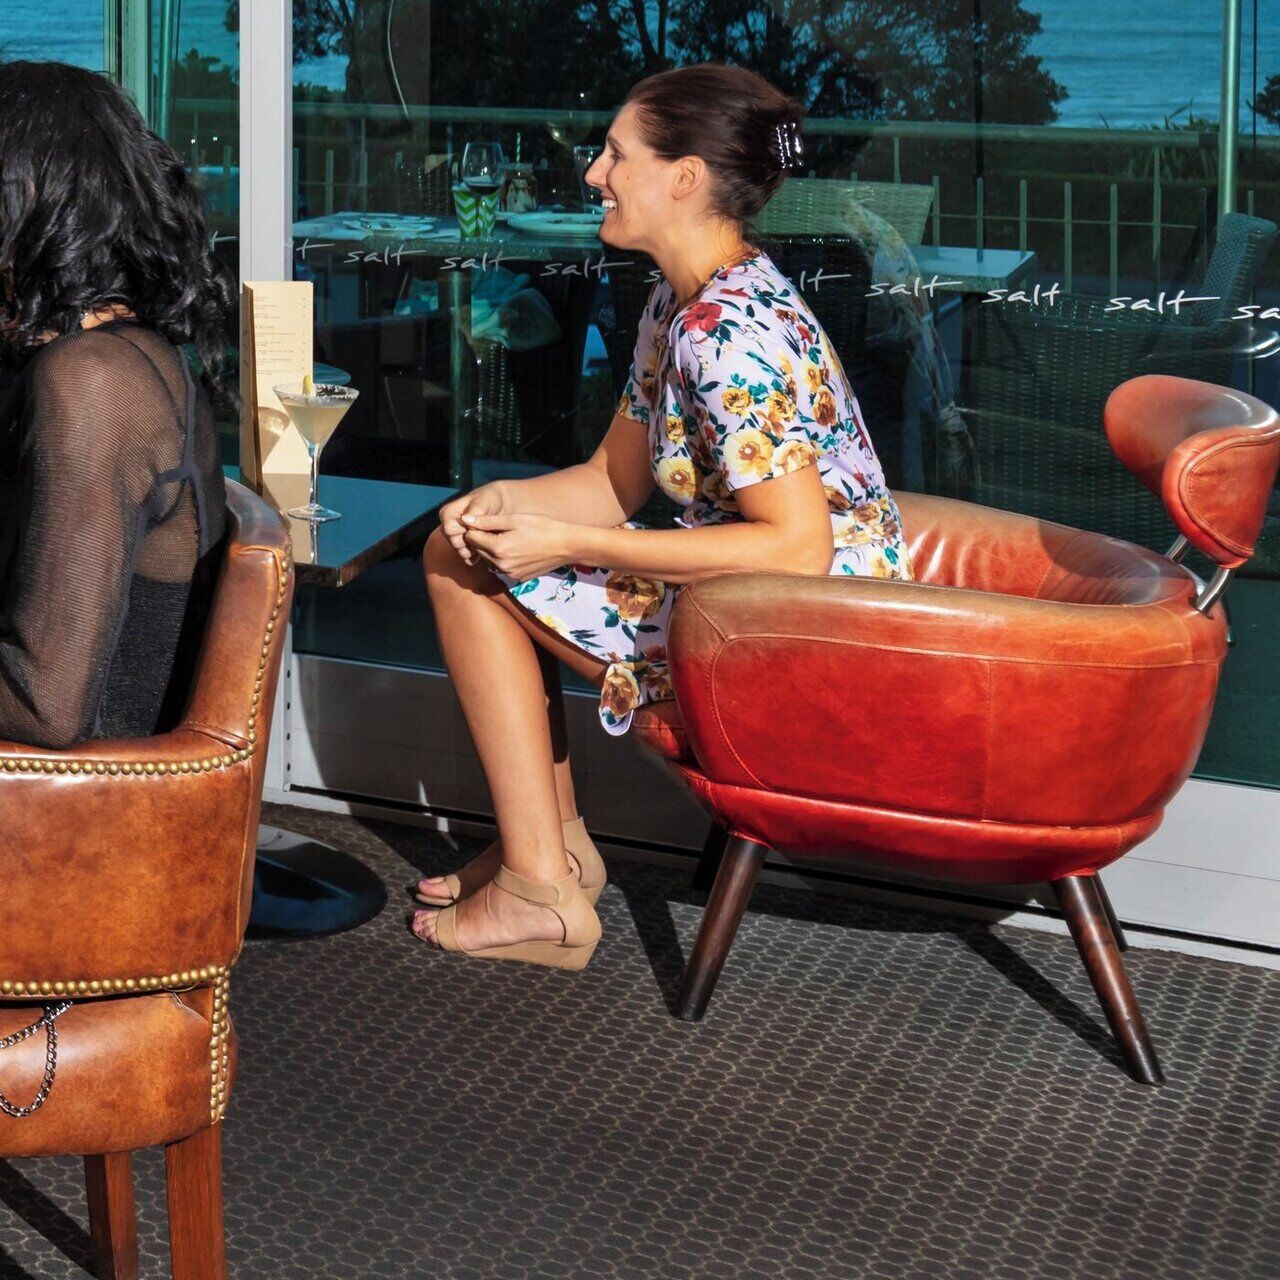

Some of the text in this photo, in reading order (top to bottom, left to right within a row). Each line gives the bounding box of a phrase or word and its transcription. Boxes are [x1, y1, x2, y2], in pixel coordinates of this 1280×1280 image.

[343, 245, 426, 266] salt
[440, 250, 530, 272] salt
[540, 256, 635, 279] salt
[865, 275, 963, 298] salt
[982, 282, 1060, 306] salt
[1105, 290, 1221, 315] salt
